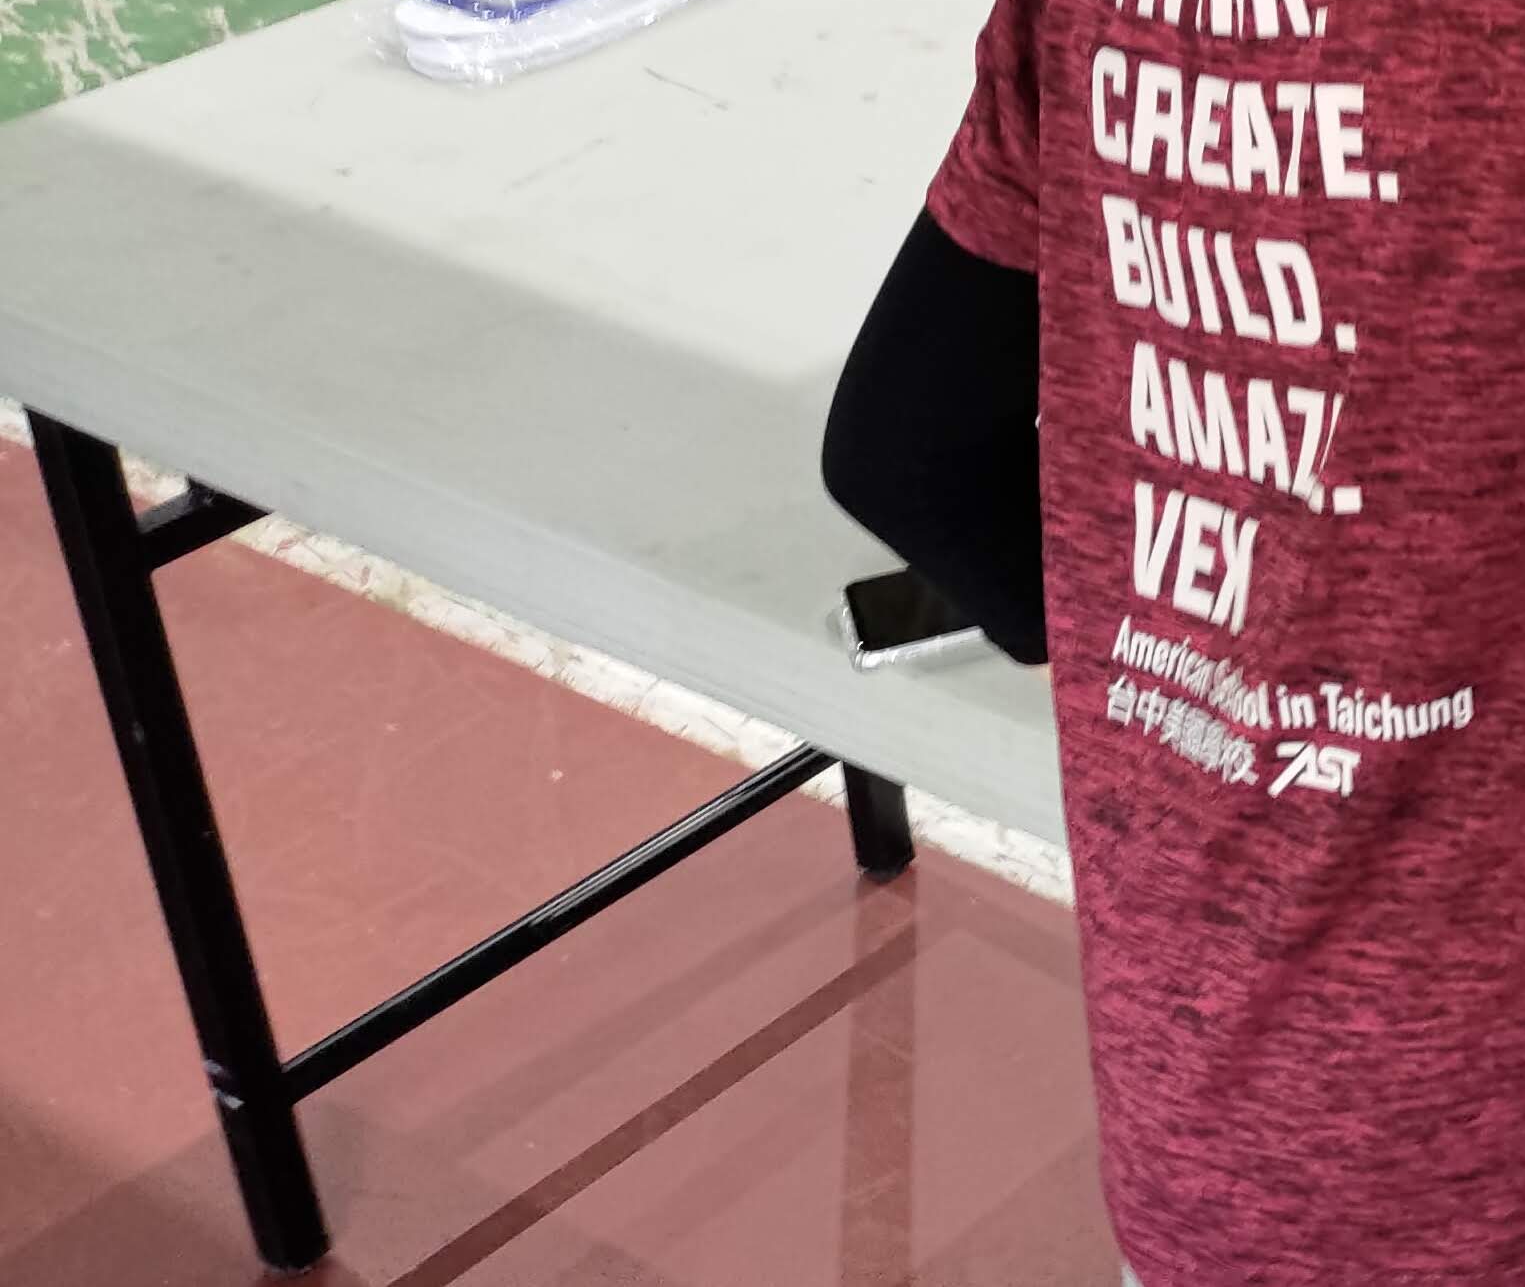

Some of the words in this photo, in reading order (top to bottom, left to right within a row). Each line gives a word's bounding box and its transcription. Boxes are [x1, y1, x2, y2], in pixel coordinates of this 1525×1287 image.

[1092, 45, 1399, 203] CREATE.
[1101, 193, 1358, 353] BUILD.
[1130, 340, 1363, 514] AMAZ.
[1133, 481, 1260, 635] VEX
[1275, 683, 1317, 731] in
[1319, 681, 1474, 742] Taichung
